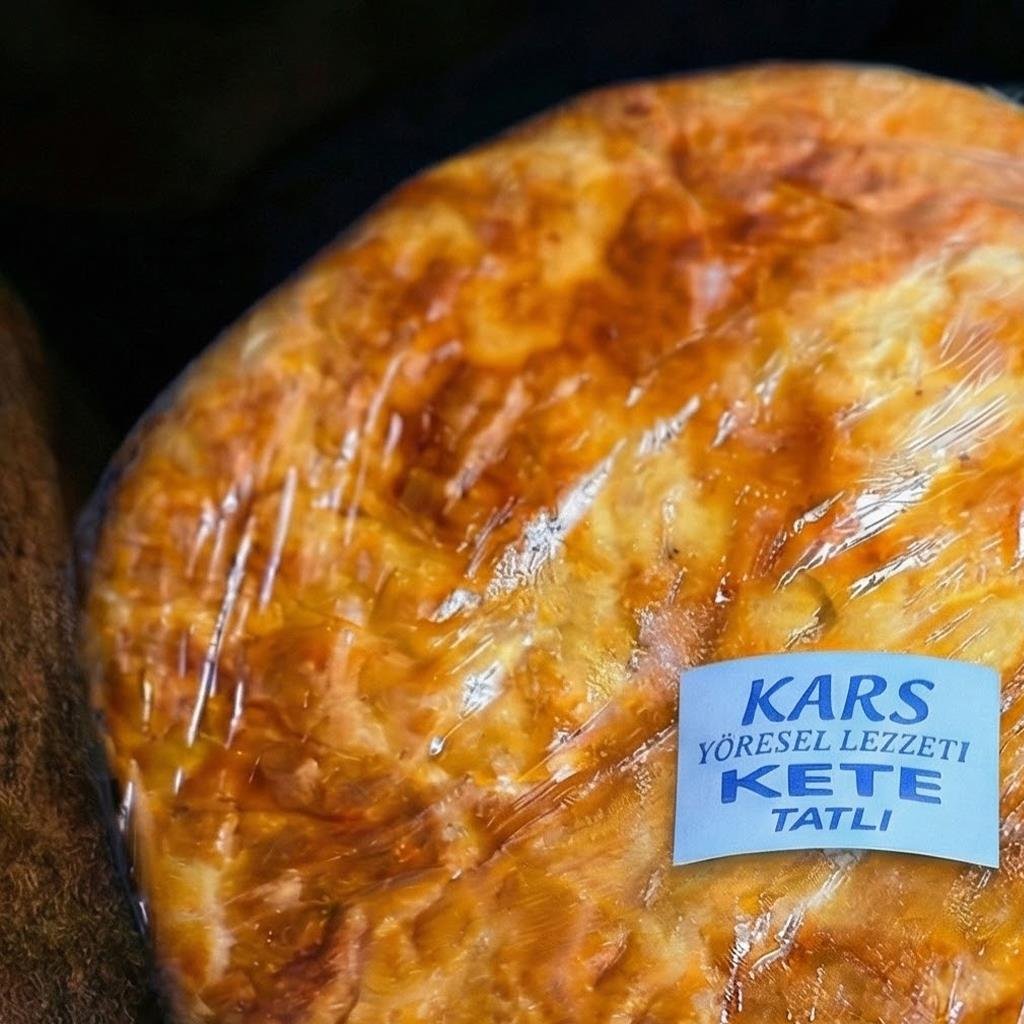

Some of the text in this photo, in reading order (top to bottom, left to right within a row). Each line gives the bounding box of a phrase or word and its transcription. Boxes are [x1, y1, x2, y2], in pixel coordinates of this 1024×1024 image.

[740, 673, 936, 728] KARS
[698, 728, 971, 766] YÖRESEL LEZZETI
[720, 762, 942, 806] KETE
[770, 806, 893, 833] TATLI
